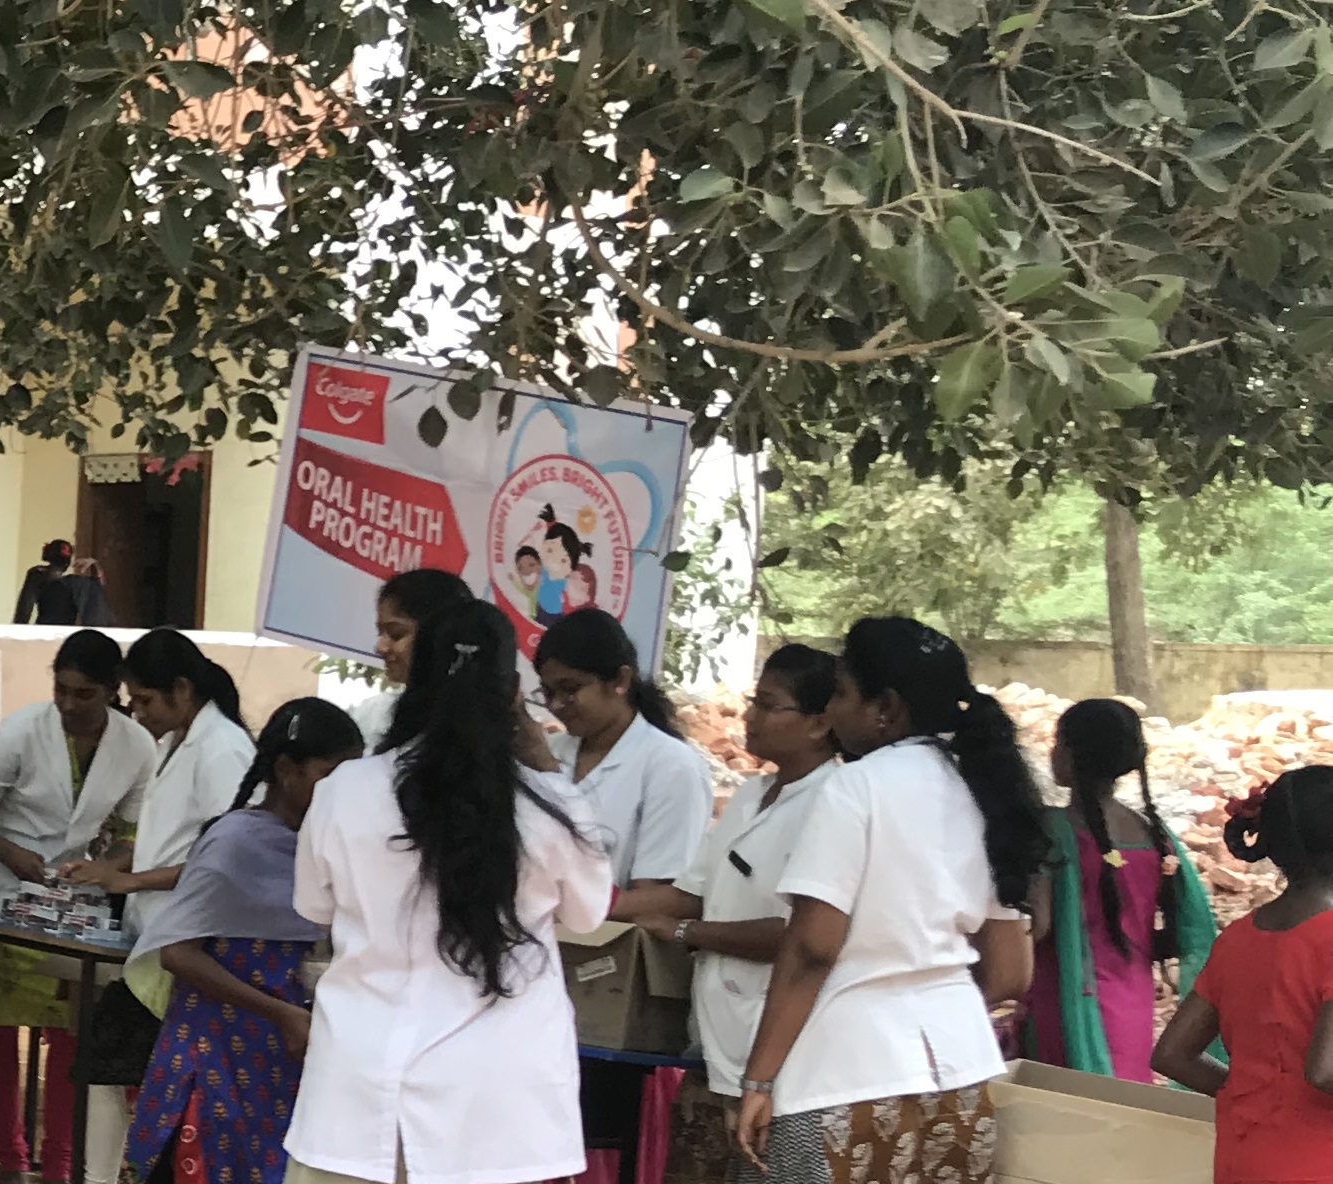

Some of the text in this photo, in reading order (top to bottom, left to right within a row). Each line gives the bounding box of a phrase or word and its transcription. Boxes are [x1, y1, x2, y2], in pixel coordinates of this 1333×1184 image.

[315, 376, 376, 407] Colgate
[296, 460, 444, 546] ORAL HEALTH
[308, 499, 423, 574] PROGRAM
